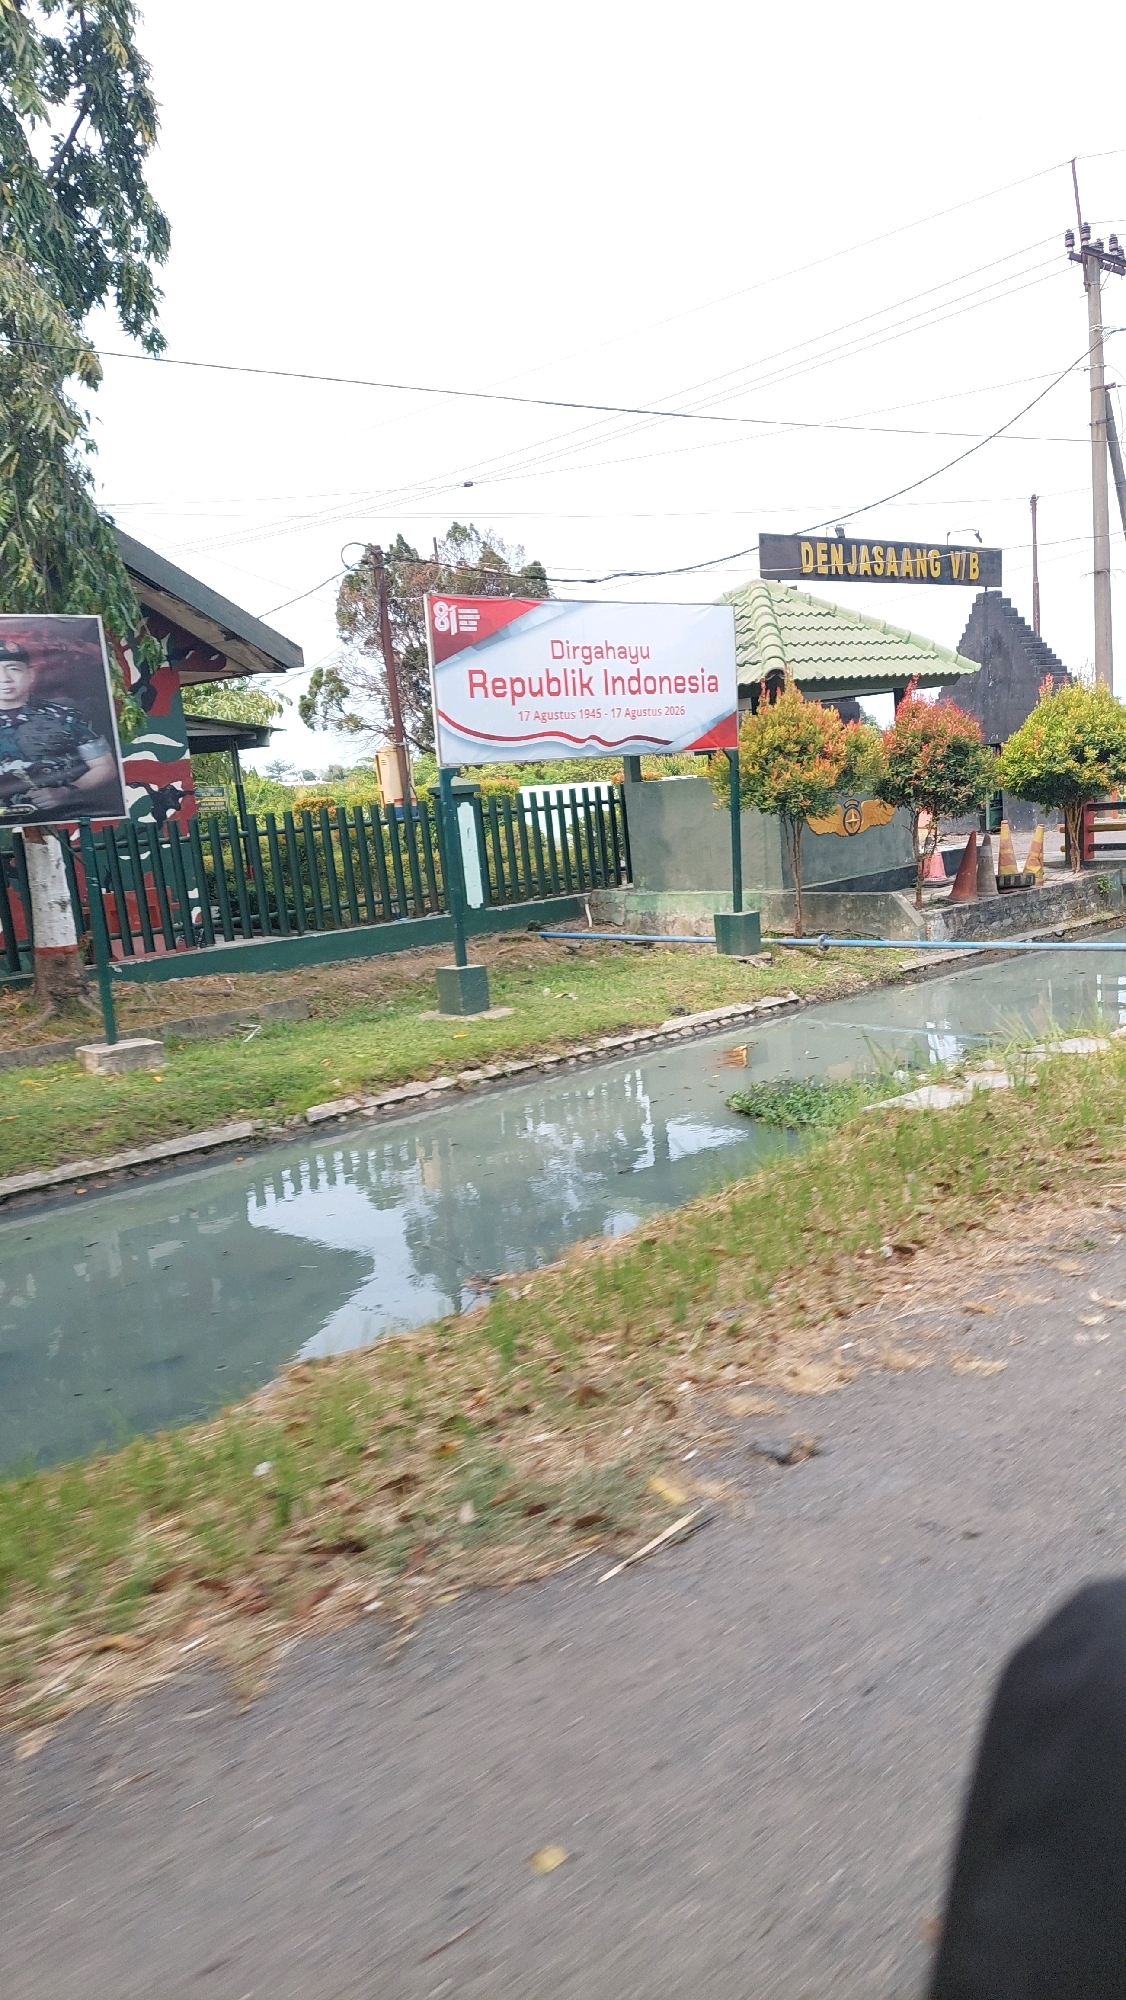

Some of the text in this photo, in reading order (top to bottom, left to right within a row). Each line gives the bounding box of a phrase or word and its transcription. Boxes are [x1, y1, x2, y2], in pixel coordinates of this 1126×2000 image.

[950, 549, 980, 580] V/B
[433, 601, 457, 636] 81
[550, 640, 650, 665] Dirgahayu
[468, 667, 720, 706] Republik Indonesia
[518, 710, 530, 722] 17
[533, 710, 576, 724] Agustus
[578, 708, 602, 720] 1945
[611, 707, 622, 719] 17
[624, 706, 663, 720] Agustus
[664, 705, 686, 716] 2026
